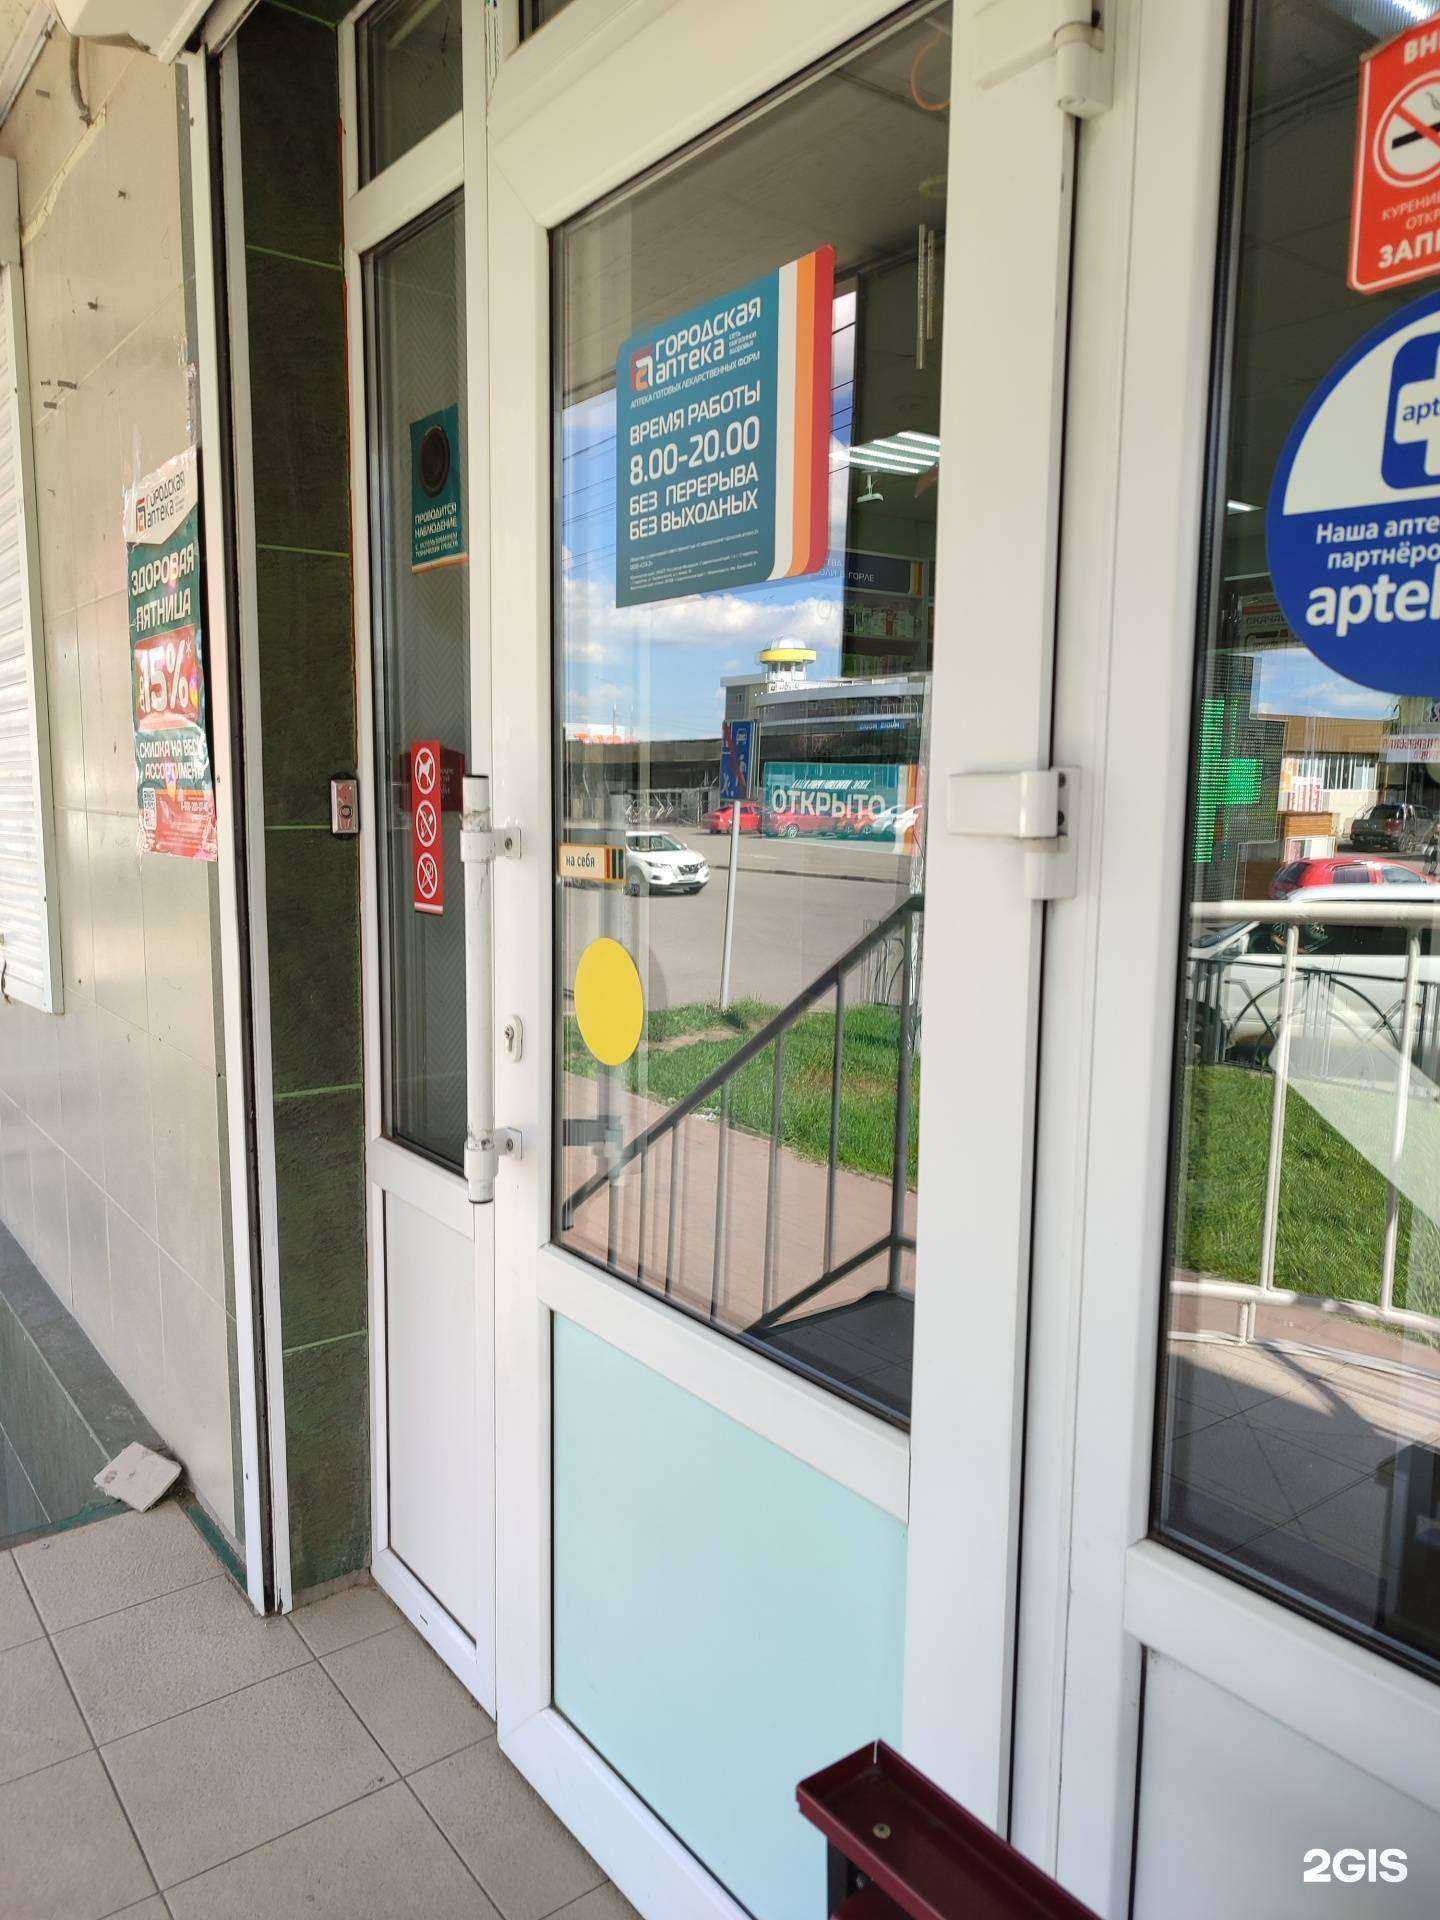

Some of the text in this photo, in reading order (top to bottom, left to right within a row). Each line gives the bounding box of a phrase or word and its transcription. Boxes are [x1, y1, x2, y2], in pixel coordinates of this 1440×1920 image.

[630, 352, 761, 409] АПТЕКА ГОТОВЫХ ЛЕКАРСТВЕННЫХ ФОРМ
[630, 381, 761, 446] ВРЕМЯ РАБОТЫ
[630, 416, 760, 486] 8.00-20.00
[630, 462, 759, 516] БЕЗ ПЕРЕРЫВА
[630, 489, 758, 541] БЕЗ ВЫХОДНЫХ
[1316, 523, 1378, 545] Наша
[131, 542, 195, 597] ЗДОРОВАЯ
[136, 588, 191, 632] ПЯТНИЦА
[139, 741, 170, 758] СКИДКА
[171, 740, 183, 757] НА
[772, 789, 886, 819] ОТКРЫТО
[565, 851, 595, 868] на себя
